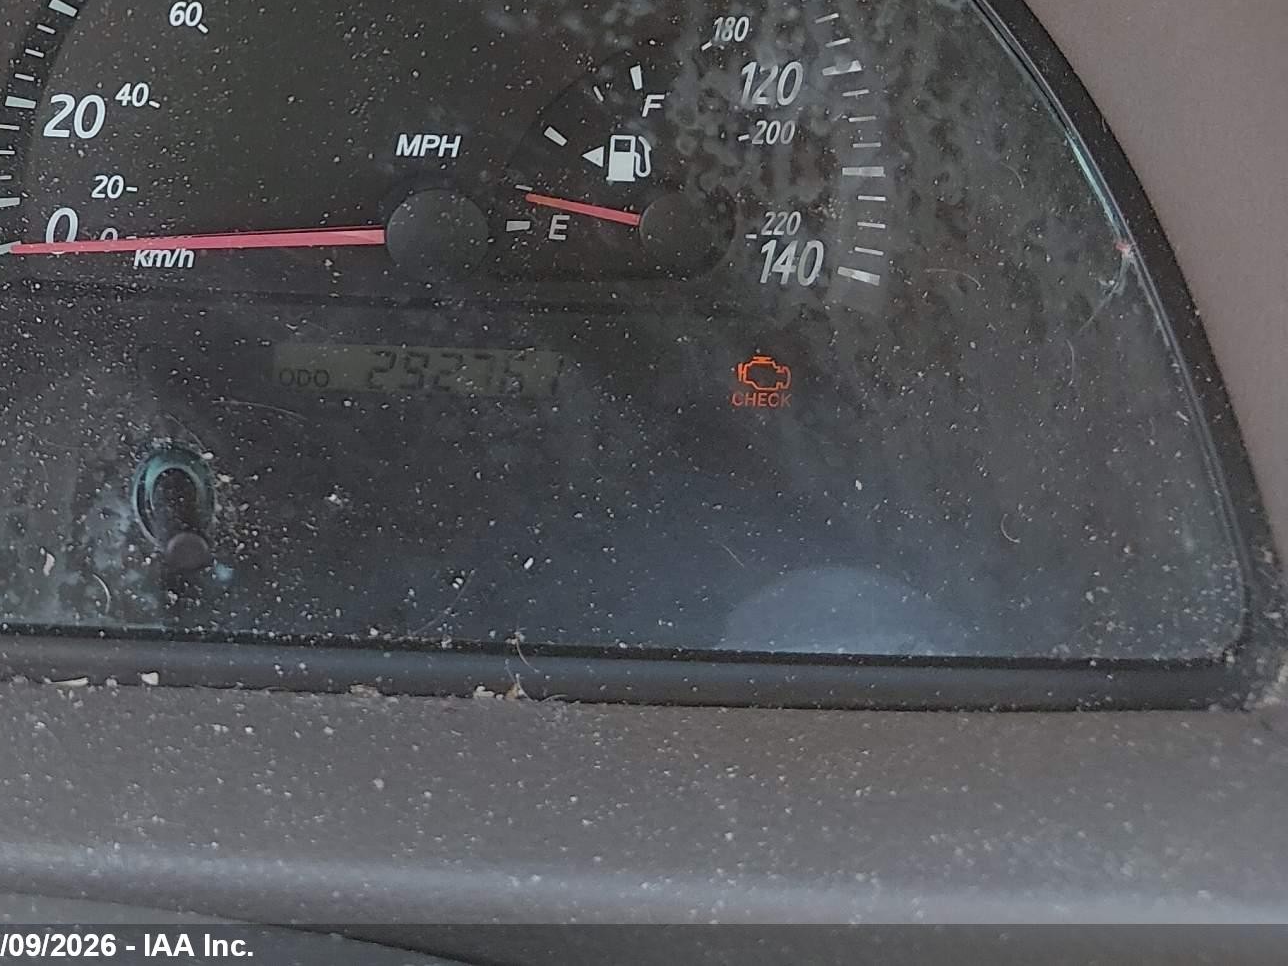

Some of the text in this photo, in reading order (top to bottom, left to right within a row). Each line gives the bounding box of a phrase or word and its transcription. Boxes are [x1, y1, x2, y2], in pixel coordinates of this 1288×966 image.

[169, 2, 203, 28] 60
[712, 16, 750, 42] 180
[115, 82, 149, 107] 40
[739, 61, 804, 106] 120
[43, 93, 106, 140] 20
[642, 94, 665, 117] F
[751, 120, 796, 145] 200
[395, 135, 462, 158] MPH
[92, 176, 124, 198] 20
[46, 208, 78, 254] 0
[548, 214, 570, 240] E
[761, 211, 801, 236] 220
[133, 249, 195, 268] km/h
[759, 240, 825, 286] 140
[279, 369, 329, 386] ODO
[731, 393, 792, 408] CHECK
